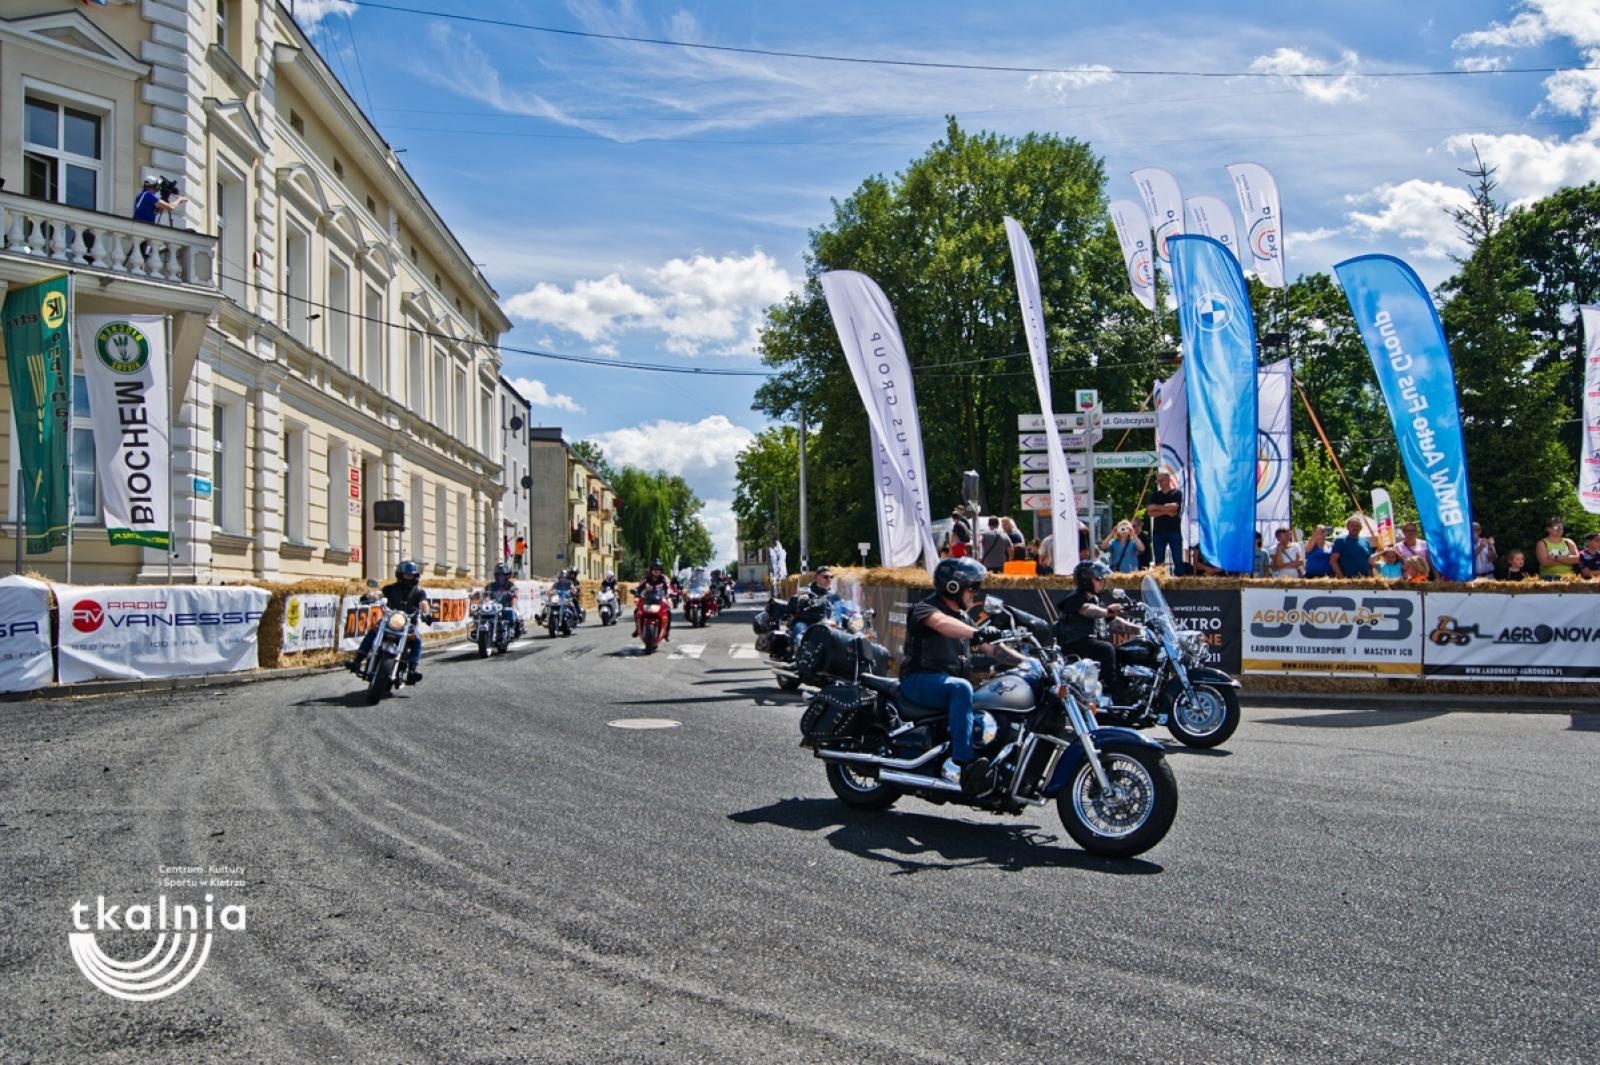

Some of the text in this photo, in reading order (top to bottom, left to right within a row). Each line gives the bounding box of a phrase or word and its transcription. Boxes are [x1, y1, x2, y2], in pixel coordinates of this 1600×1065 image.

[1096, 456, 1149, 466] Stadion Miejski
[107, 601, 168, 610] RADIO
[1250, 595, 1414, 640] JCB
[1252, 609, 1349, 625] AGRONOVA
[1295, 645, 1346, 655] TELESKOPOWE
[1364, 647, 1397, 656] MASZYNY
[1399, 648, 1413, 656] JCB
